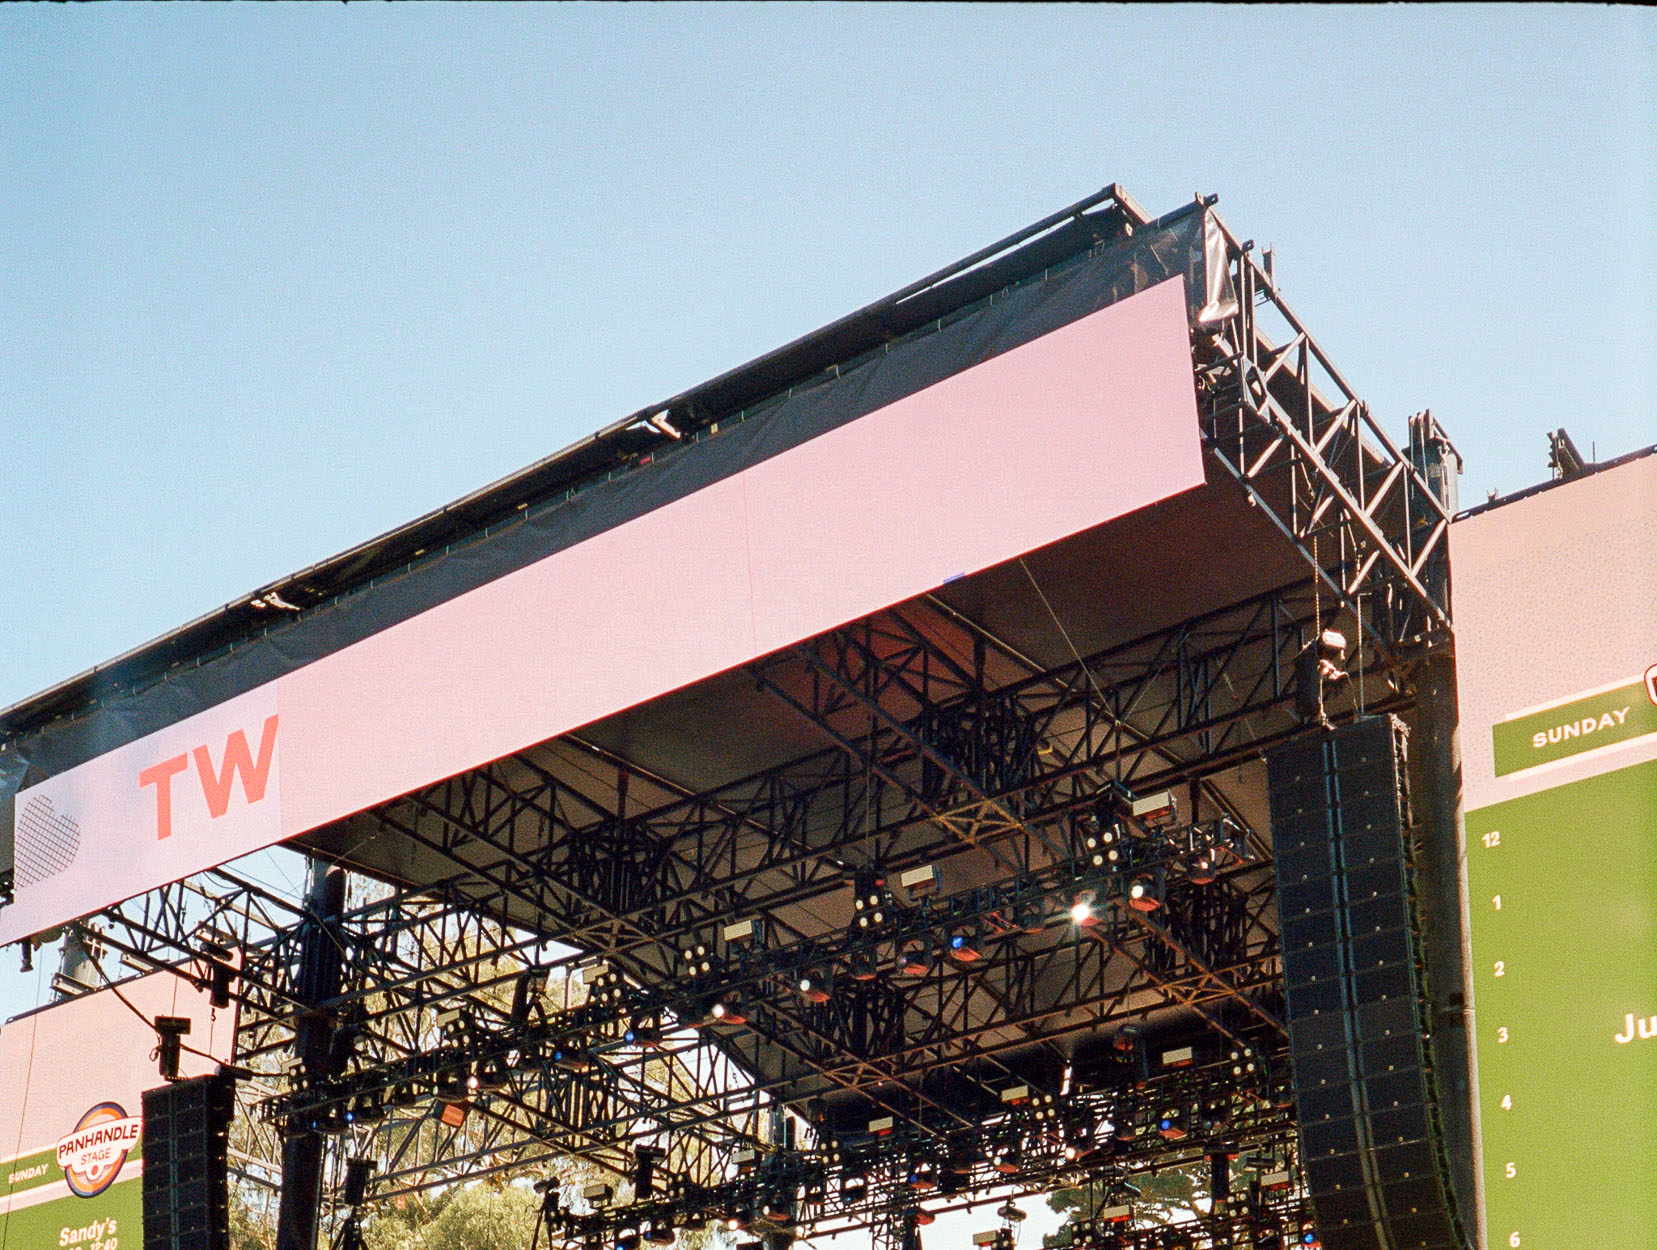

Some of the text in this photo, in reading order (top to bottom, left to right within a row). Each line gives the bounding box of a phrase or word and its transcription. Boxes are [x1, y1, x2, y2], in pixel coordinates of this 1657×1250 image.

[1534, 706, 1630, 748] SUNDAY
[139, 714, 279, 841] TW
[1483, 831, 1501, 848] 12
[1492, 895, 1502, 910] 1
[1494, 961, 1505, 977] 2
[1497, 1027, 1508, 1043] 3
[1615, 1013, 1657, 1043] Ju
[1501, 1095, 1512, 1111] 4
[58, 1124, 139, 1159] PANHANDLE
[80, 1148, 111, 1166] STAGE
[8, 1163, 49, 1184] SUNDAY
[1505, 1162, 1516, 1178] 5
[59, 1217, 118, 1247] Sandy's
[1509, 1231, 1520, 1248] 6
